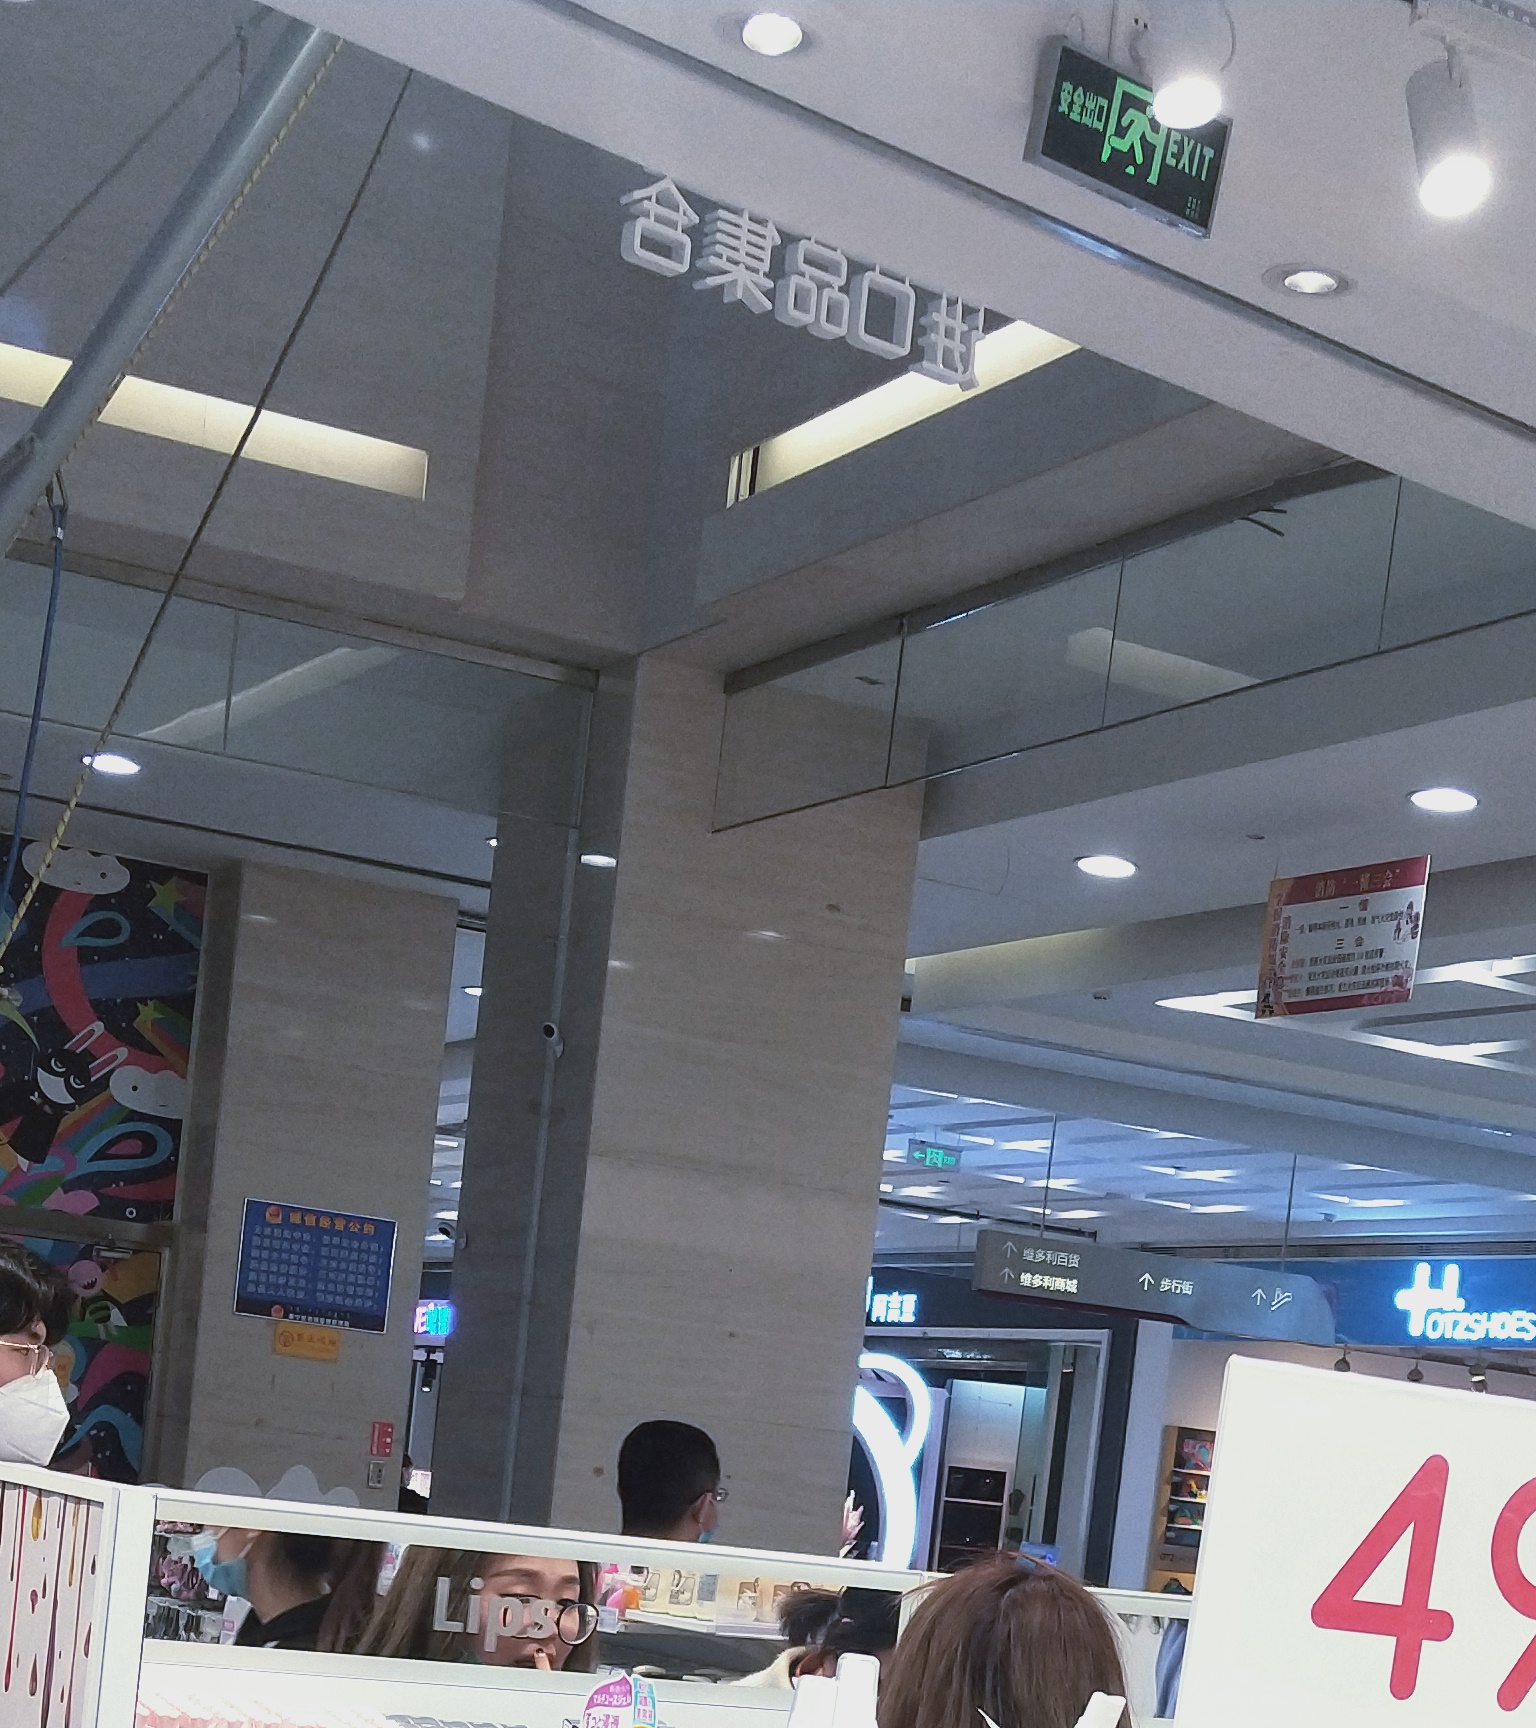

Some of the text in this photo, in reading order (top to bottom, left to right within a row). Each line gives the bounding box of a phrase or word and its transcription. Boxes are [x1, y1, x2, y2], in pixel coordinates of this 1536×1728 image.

[1058, 81, 1109, 132] 安全出口
[1166, 129, 1215, 182] EXIT
[1023, 1246, 1080, 1269] 维多利百货
[1019, 1272, 1078, 1295] 维多利商城
[1159, 1278, 1194, 1295] 步行街
[433, 1576, 557, 1653] Lips
